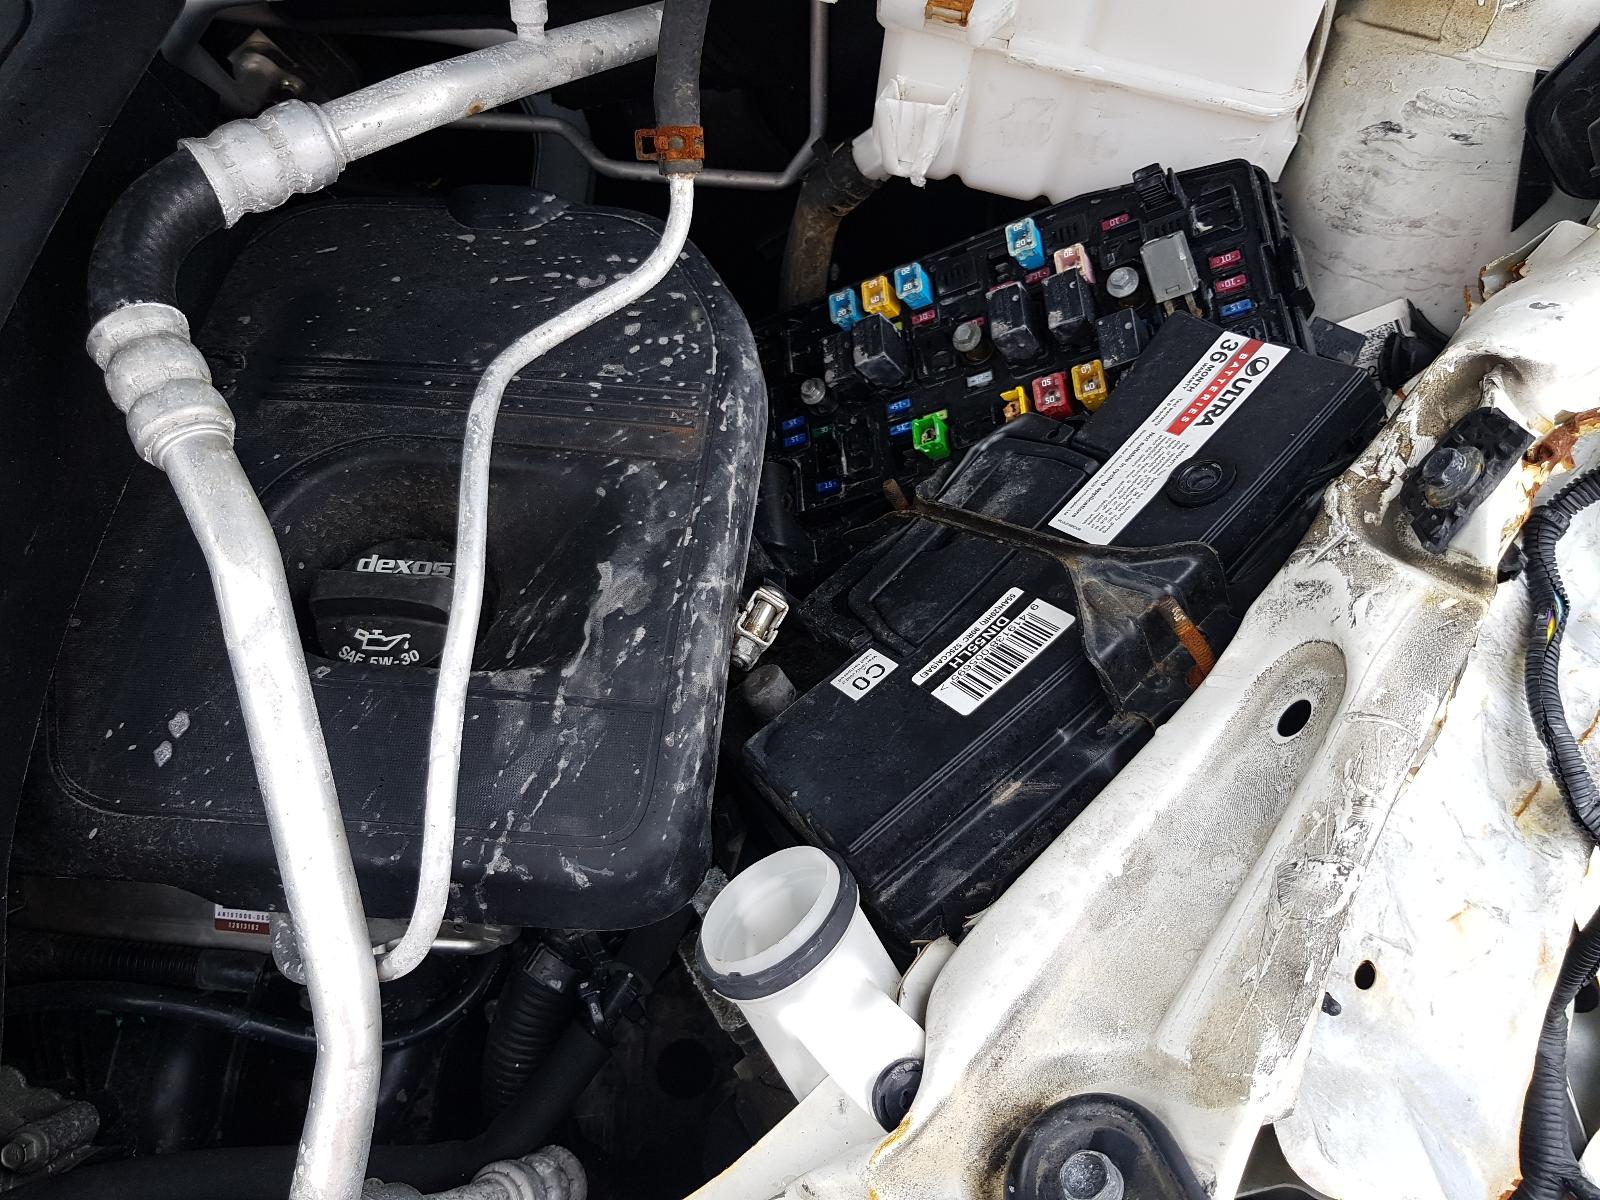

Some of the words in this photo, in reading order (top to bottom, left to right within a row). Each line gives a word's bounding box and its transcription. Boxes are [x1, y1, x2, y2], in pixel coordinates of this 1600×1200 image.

[1016, 239, 1026, 248] 20
[1220, 253, 1232, 264] 10
[903, 282, 912, 291] 20
[837, 308, 847, 317] 20
[1206, 338, 1241, 364] 36
[1178, 352, 1249, 423] BATTERIES
[1180, 362, 1208, 389] WARRANTY
[1185, 364, 1215, 392] MONTH
[1045, 395, 1055, 404] 50
[1193, 376, 1253, 430] ULTRA
[978, 593, 1016, 626] 55AH(20HR)
[1028, 602, 1039, 611] 9
[948, 615, 1010, 669] DIN55LH
[960, 626, 981, 642] 90RC
[988, 613, 1028, 648] 419138
[918, 642, 962, 679] 525CCA(SAE)
[949, 647, 990, 682] 005695
